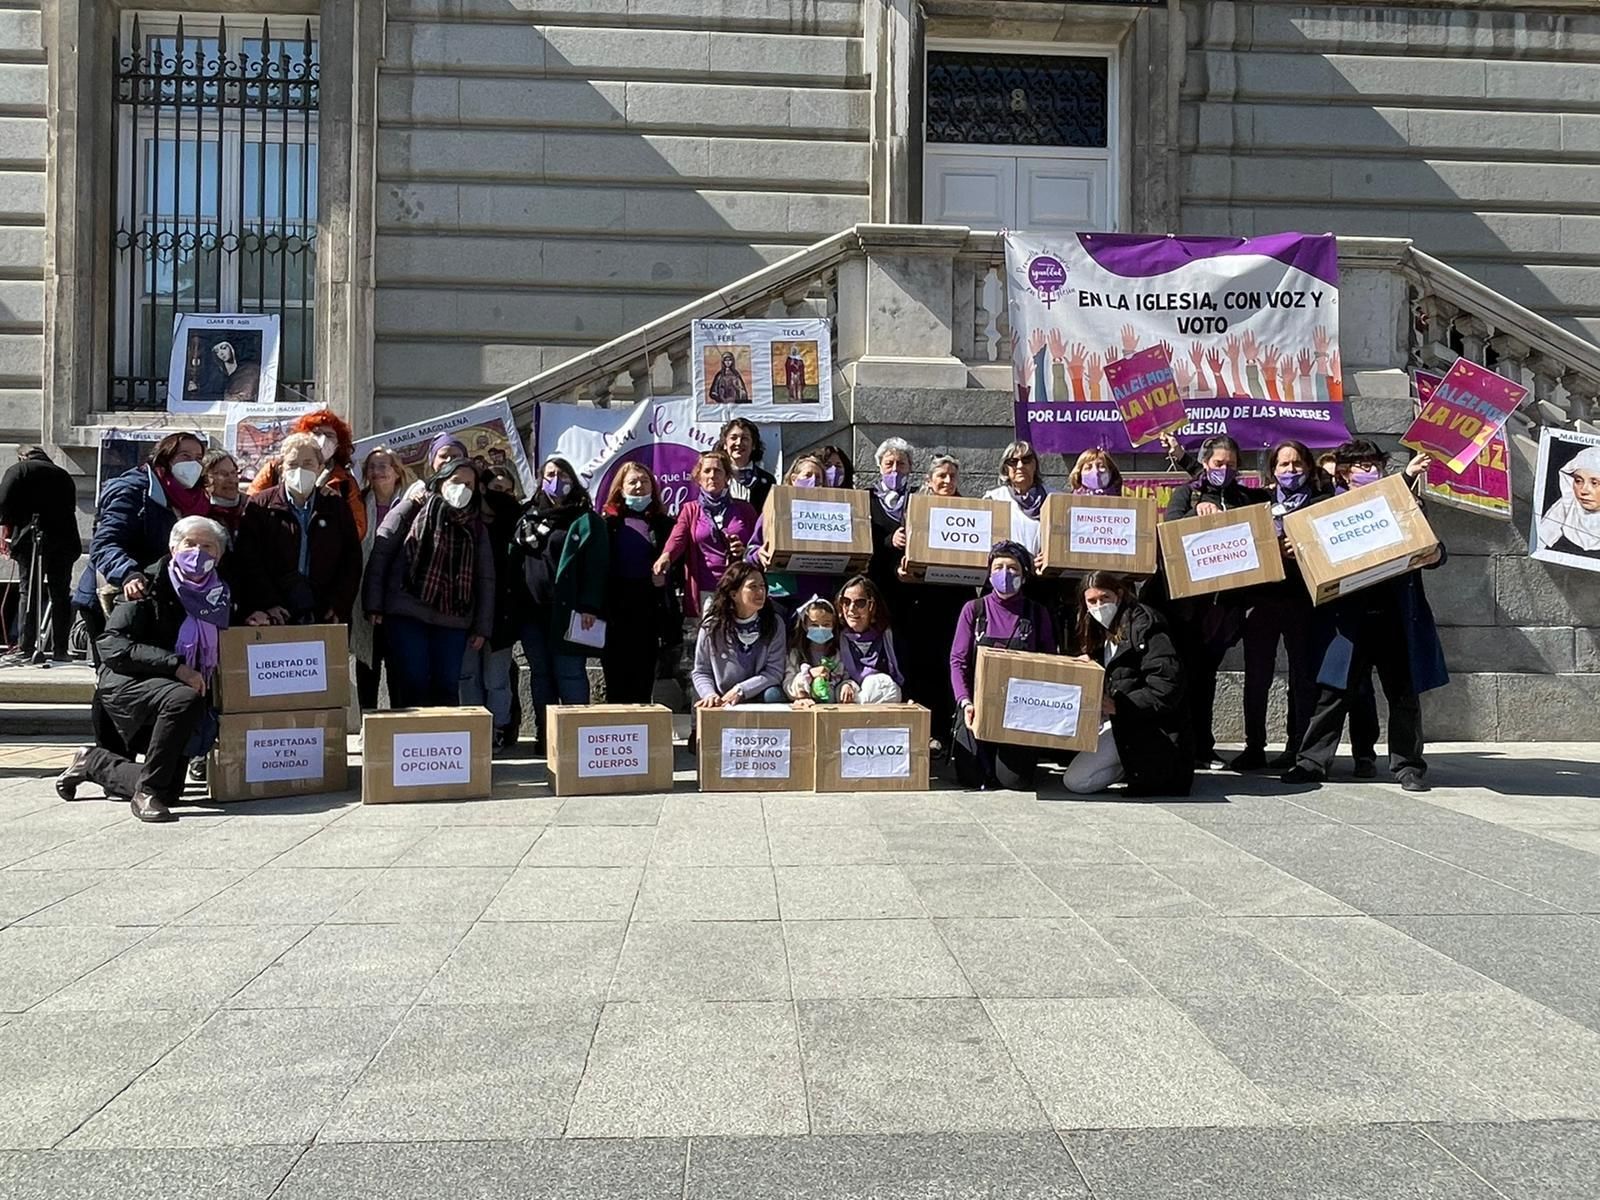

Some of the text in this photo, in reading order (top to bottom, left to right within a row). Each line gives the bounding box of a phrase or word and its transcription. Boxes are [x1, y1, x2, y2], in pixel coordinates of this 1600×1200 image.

[1079, 290, 1323, 311] EN LA IGLESIA, CON VOZ Y
[700, 322, 743, 330] DIACONISA
[1177, 317, 1228, 335] VOTO
[782, 329, 805, 337] TECLA
[1142, 383, 1179, 411] VOZ
[1028, 410, 1054, 422] POR
[1056, 409, 1072, 422] LA
[1184, 407, 1230, 420] GNIDAD
[1233, 406, 1250, 418] DE
[1252, 406, 1277, 418] LAS
[1279, 408, 1331, 421] MUJERES
[1120, 399, 1144, 422] LA
[1420, 402, 1451, 426] LA
[648, 405, 677, 438] de
[388, 417, 469, 446] MARÍA MAGDALENA
[1178, 422, 1227, 435] IGLESIA
[1449, 412, 1495, 445] VOZ
[660, 473, 680, 484] que
[682, 471, 693, 481] la
[799, 511, 844, 521] FAMILIAS
[1076, 515, 1130, 524] MINISTERIO
[1332, 509, 1374, 530] PLENO
[797, 522, 846, 532] DIVERSAS
[946, 516, 976, 528] CON
[1093, 526, 1113, 535] POR
[1329, 519, 1389, 545] DERECHO
[941, 531, 980, 544] VOTO
[1078, 537, 1128, 546] BAUTISMO
[1191, 538, 1248, 557] LIDERAZGO
[1197, 550, 1248, 567] FEMENINO
[255, 657, 319, 669] LIBERTAD DE
[257, 669, 318, 680] CONCIENCIA
[1013, 696, 1074, 711] SINODALIDAD
[253, 737, 318, 748] RESPETADAS
[587, 733, 639, 744] DISFRUTE
[735, 736, 778, 746] ROSTRO
[274, 749, 297, 757] Y EN
[402, 746, 462, 757] CELIBATO
[594, 746, 633, 756] DE LOS
[730, 749, 782, 758] FEMENINO
[847, 745, 904, 756] CON VOZ
[261, 759, 309, 769] DIGNIDAD
[400, 761, 464, 772] OPCIONAL
[588, 758, 639, 769] CUERPOS
[735, 761, 776, 770] DE DIOS
